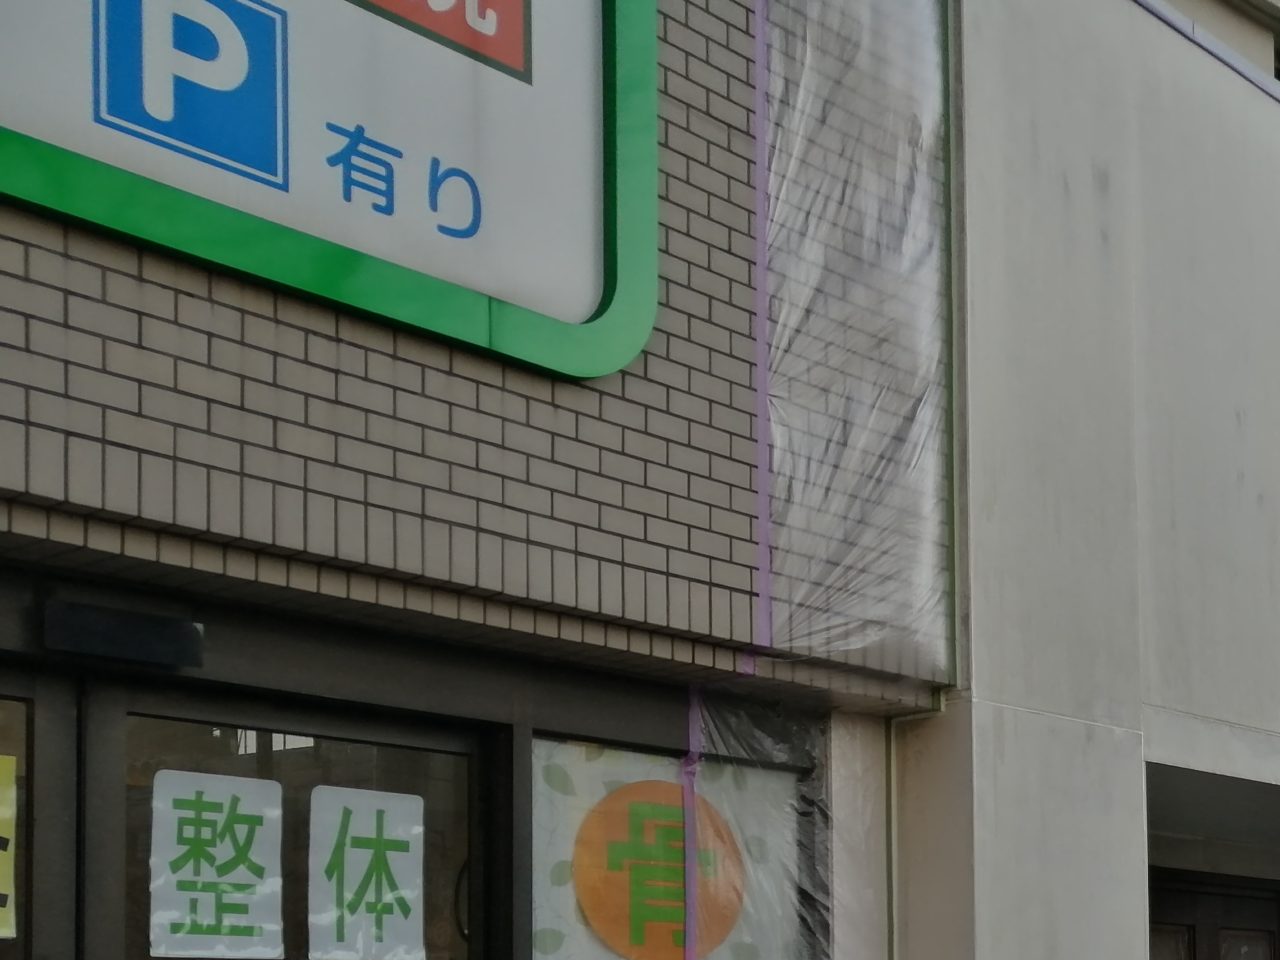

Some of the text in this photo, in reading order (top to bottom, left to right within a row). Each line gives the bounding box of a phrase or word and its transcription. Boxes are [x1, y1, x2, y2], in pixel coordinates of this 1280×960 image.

[142, 0, 483, 239] P 有り
[168, 788, 412, 945] 整体
